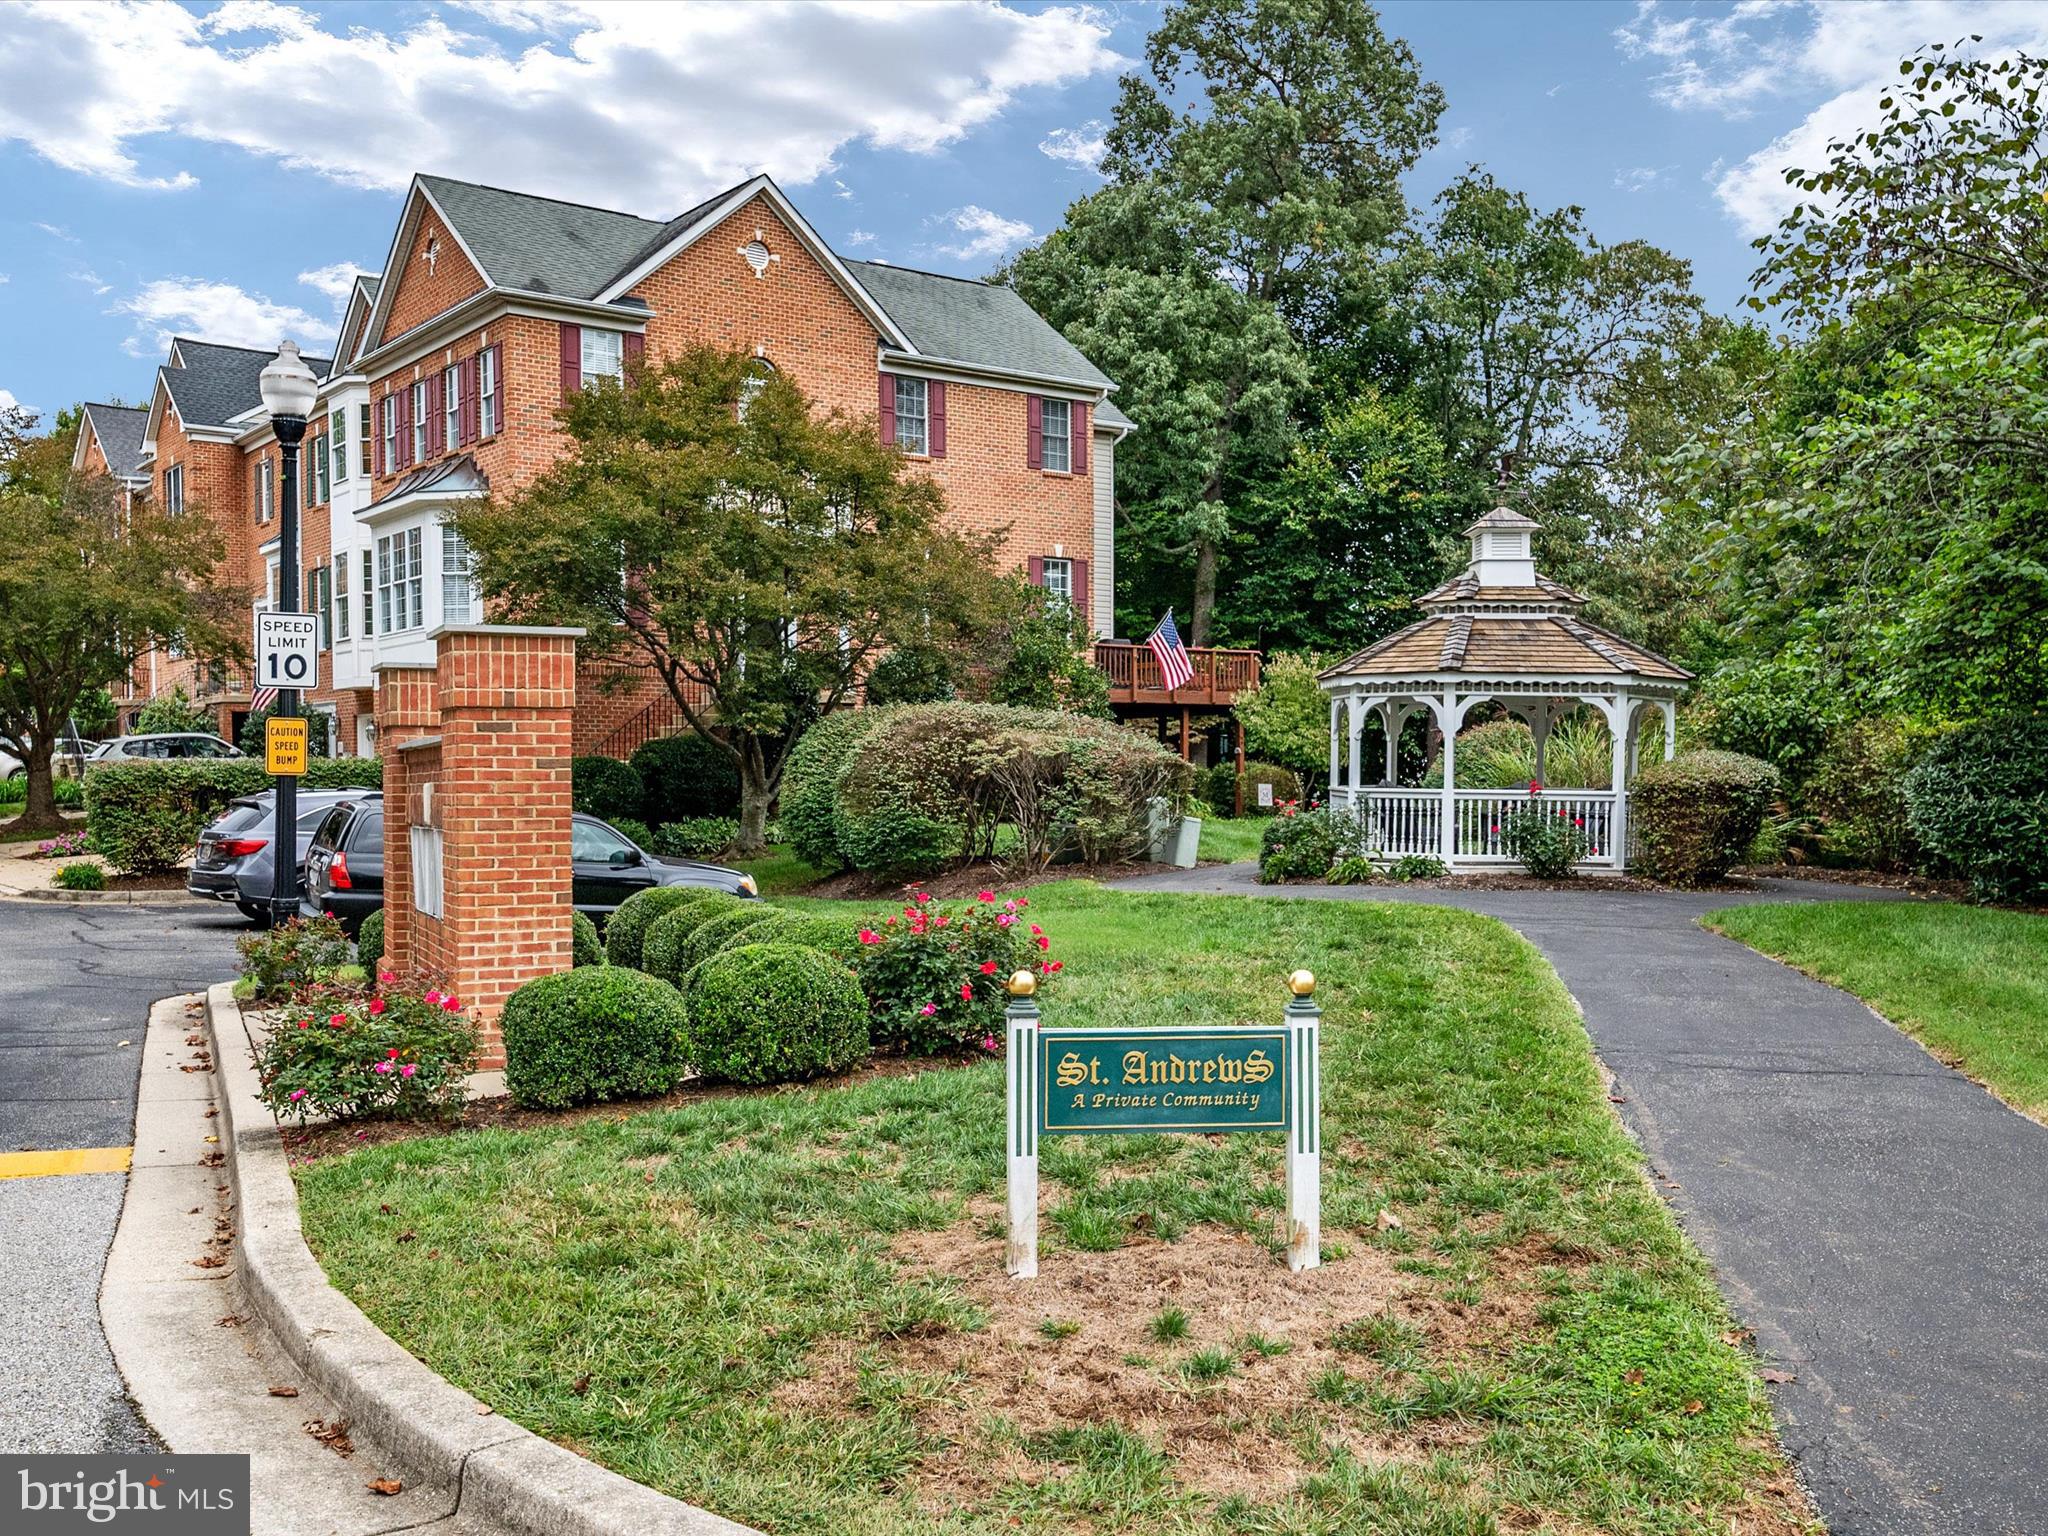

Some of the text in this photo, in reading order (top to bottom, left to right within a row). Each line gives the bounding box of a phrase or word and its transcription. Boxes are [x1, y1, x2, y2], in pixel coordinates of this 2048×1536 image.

[263, 621, 313, 633] SPEED
[268, 637, 307, 648] LIMIT
[268, 653, 307, 680] 10
[270, 727, 304, 737] CAUTION
[274, 741, 299, 751] SPEED
[276, 755, 298, 765] BUMP
[1056, 1052, 1109, 1087] St.
[1071, 1092, 1260, 1111] A Private Community
